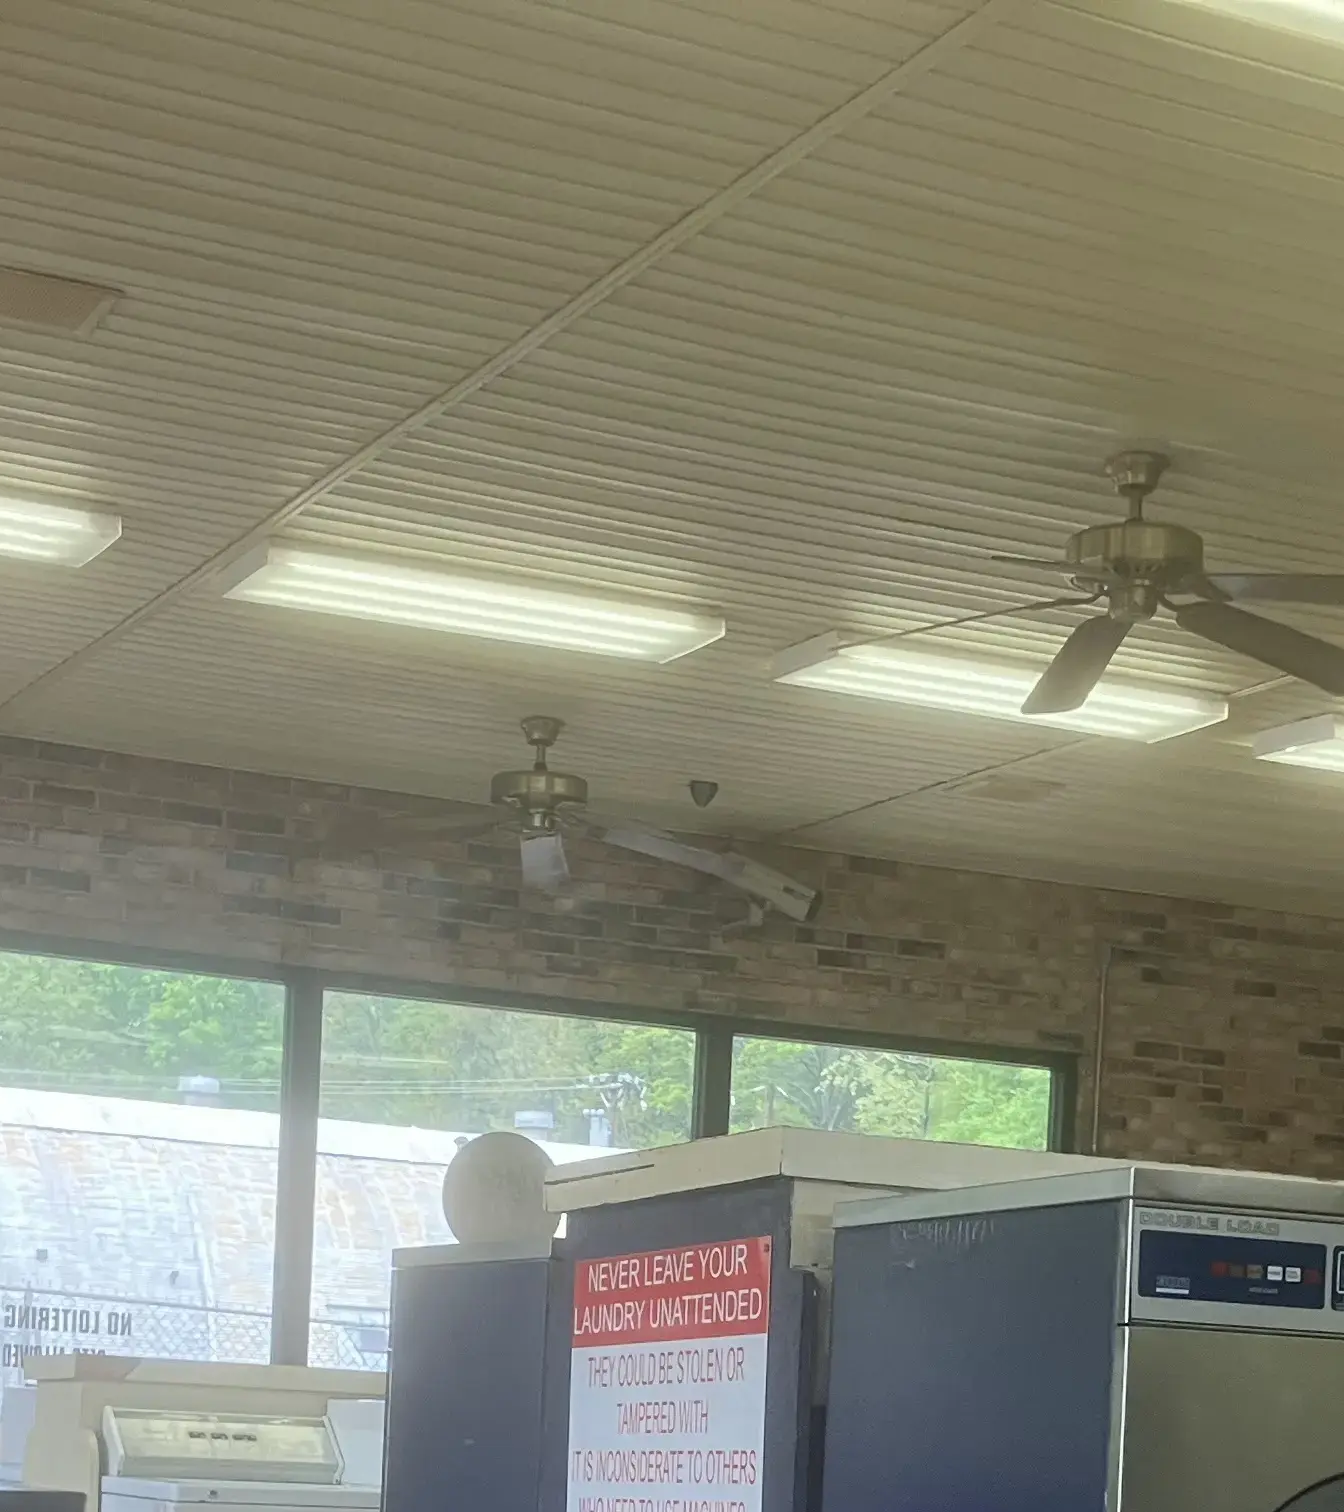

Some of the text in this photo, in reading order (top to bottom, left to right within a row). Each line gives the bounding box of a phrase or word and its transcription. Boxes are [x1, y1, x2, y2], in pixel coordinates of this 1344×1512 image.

[1140, 1211, 1220, 1231] DOUBLE
[588, 1244, 748, 1293] NEVER LEAVE YOUR
[573, 1288, 763, 1335] LAUNDRY UNATTENDED
[588, 1346, 746, 1388] THEY COULD BE STOLEN OR
[616, 1400, 708, 1435] TAMPERED WITH
[571, 1449, 757, 1485] IT IS INCONSIDERATE TO OTHERS
